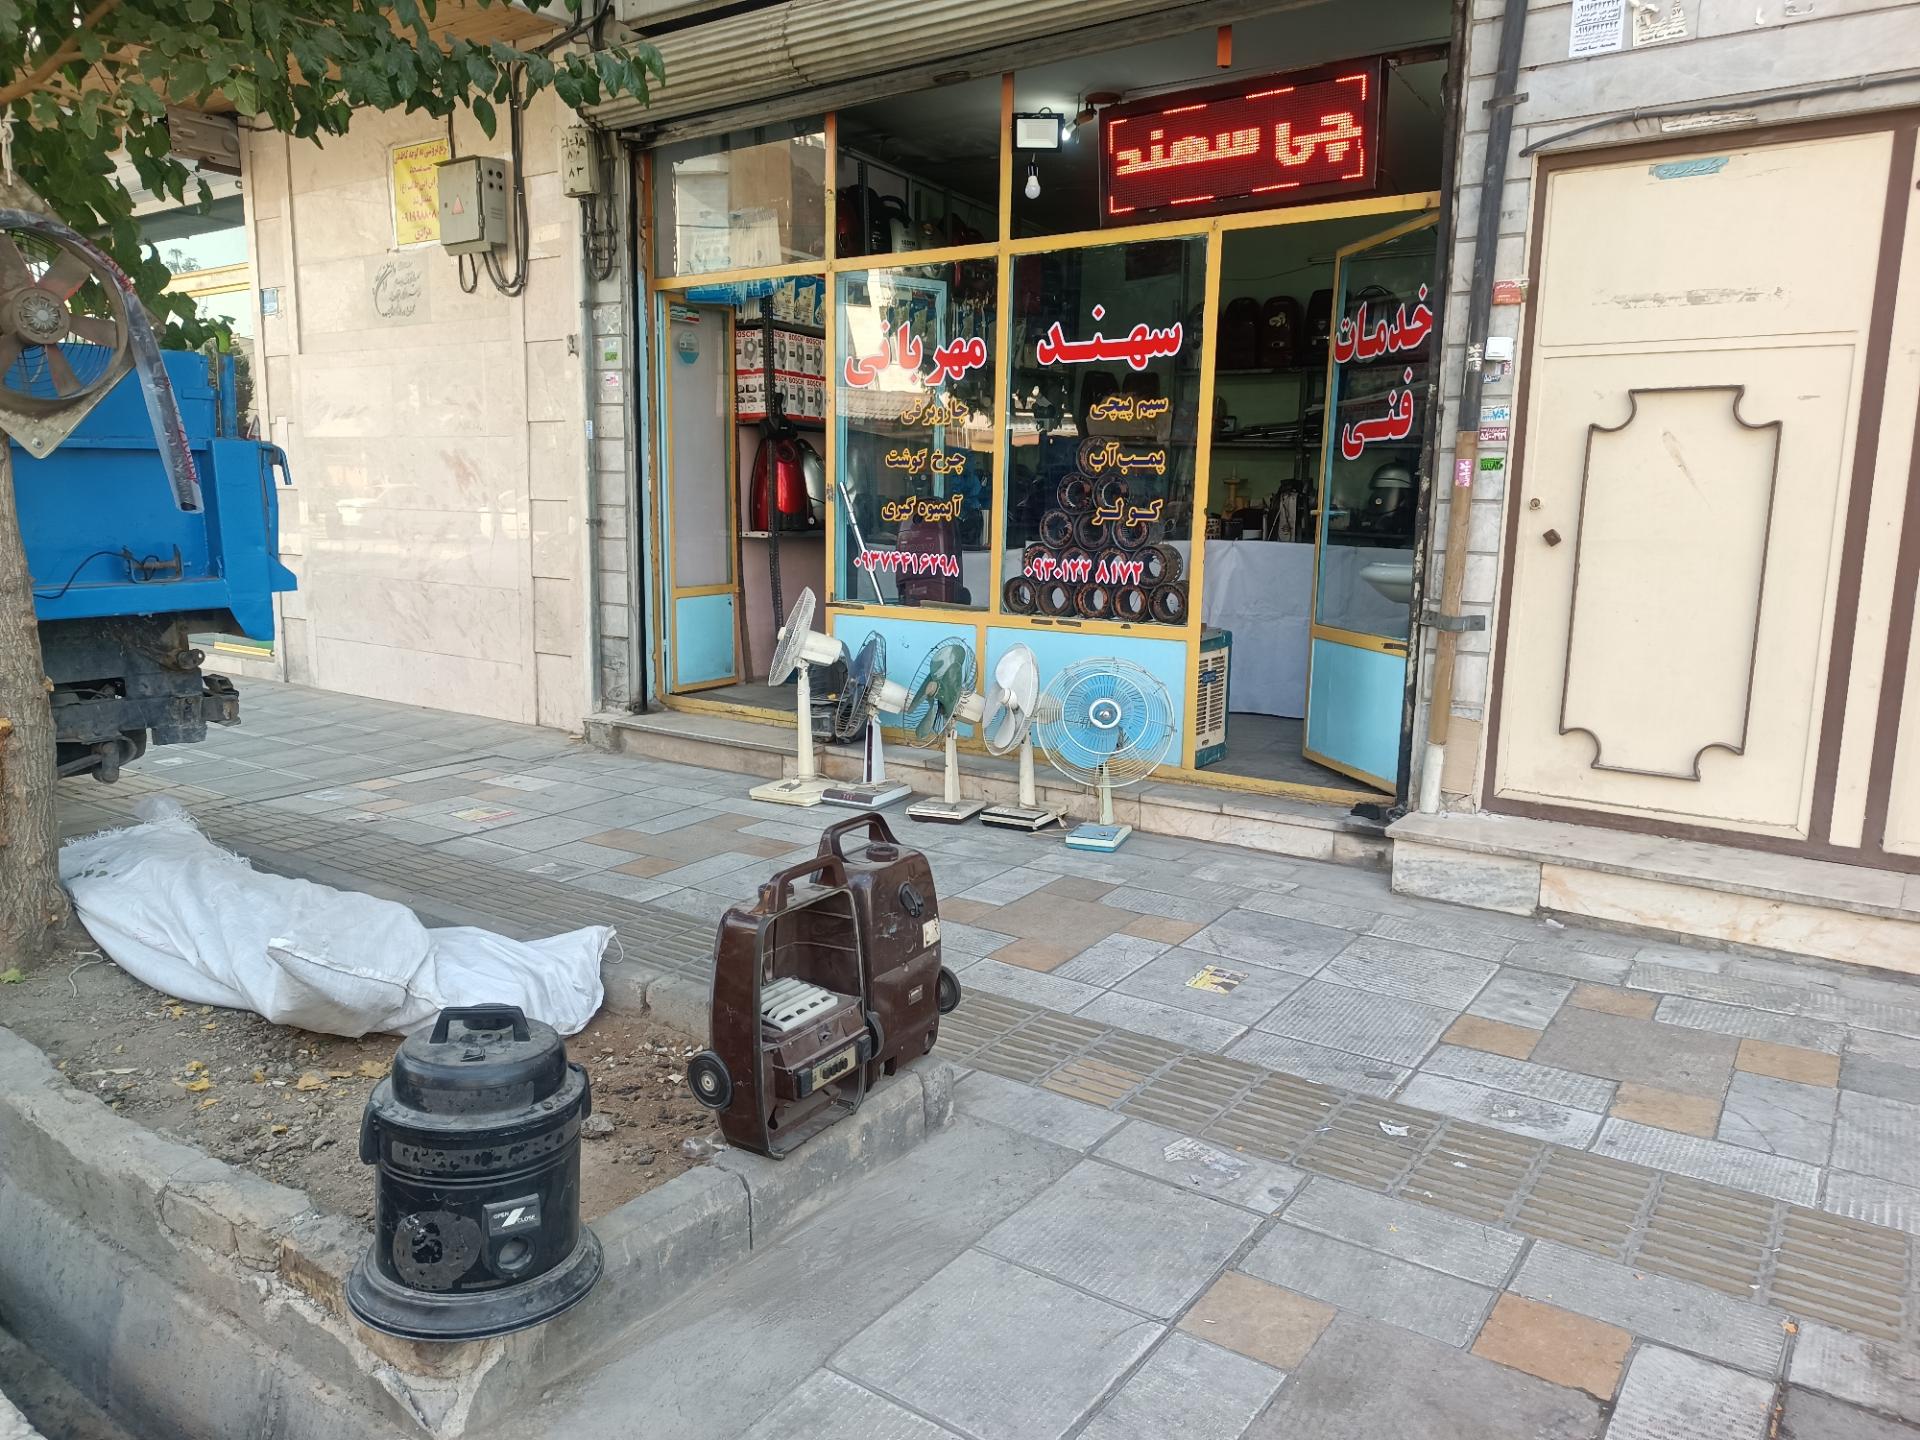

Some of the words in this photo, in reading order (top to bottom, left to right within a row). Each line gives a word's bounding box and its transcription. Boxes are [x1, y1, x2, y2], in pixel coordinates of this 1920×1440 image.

[1116, 128, 1260, 176] سهند
[1036, 303, 1183, 371] سهند
[1334, 283, 1433, 364] خدمات
[844, 319, 987, 387] مهربانی
[900, 398, 969, 427] جاروبرقی
[1090, 396, 1134, 422] پیچی
[1136, 396, 1169, 419] سیم
[1342, 367, 1414, 460] فنی
[885, 448, 928, 474] گوشت
[931, 449, 966, 475] چرخ
[1089, 441, 1119, 472] آب
[881, 495, 917, 522] گیری
[917, 494, 964, 521] آبمیوه
